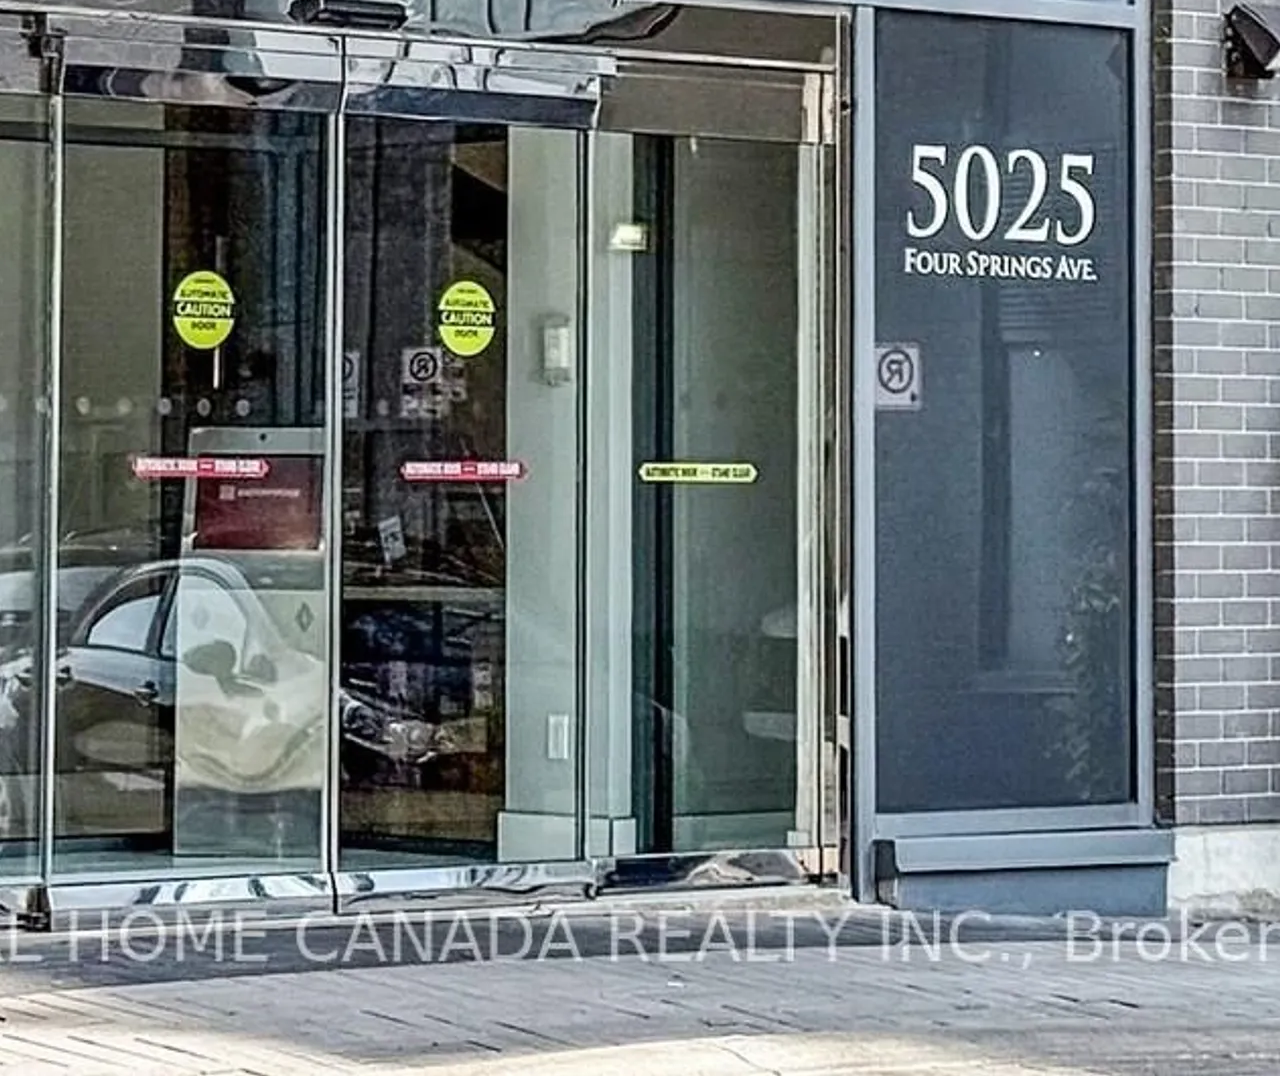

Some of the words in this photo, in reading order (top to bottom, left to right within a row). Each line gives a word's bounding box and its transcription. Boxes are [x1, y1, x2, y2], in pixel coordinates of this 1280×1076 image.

[906, 144, 1097, 245] 5025
[904, 247, 963, 275] FOUR
[966, 251, 1053, 279] SPRINGS
[1056, 255, 1097, 280] AVE.
[176, 302, 231, 317] CAUTION
[441, 311, 492, 325] CAUTION
